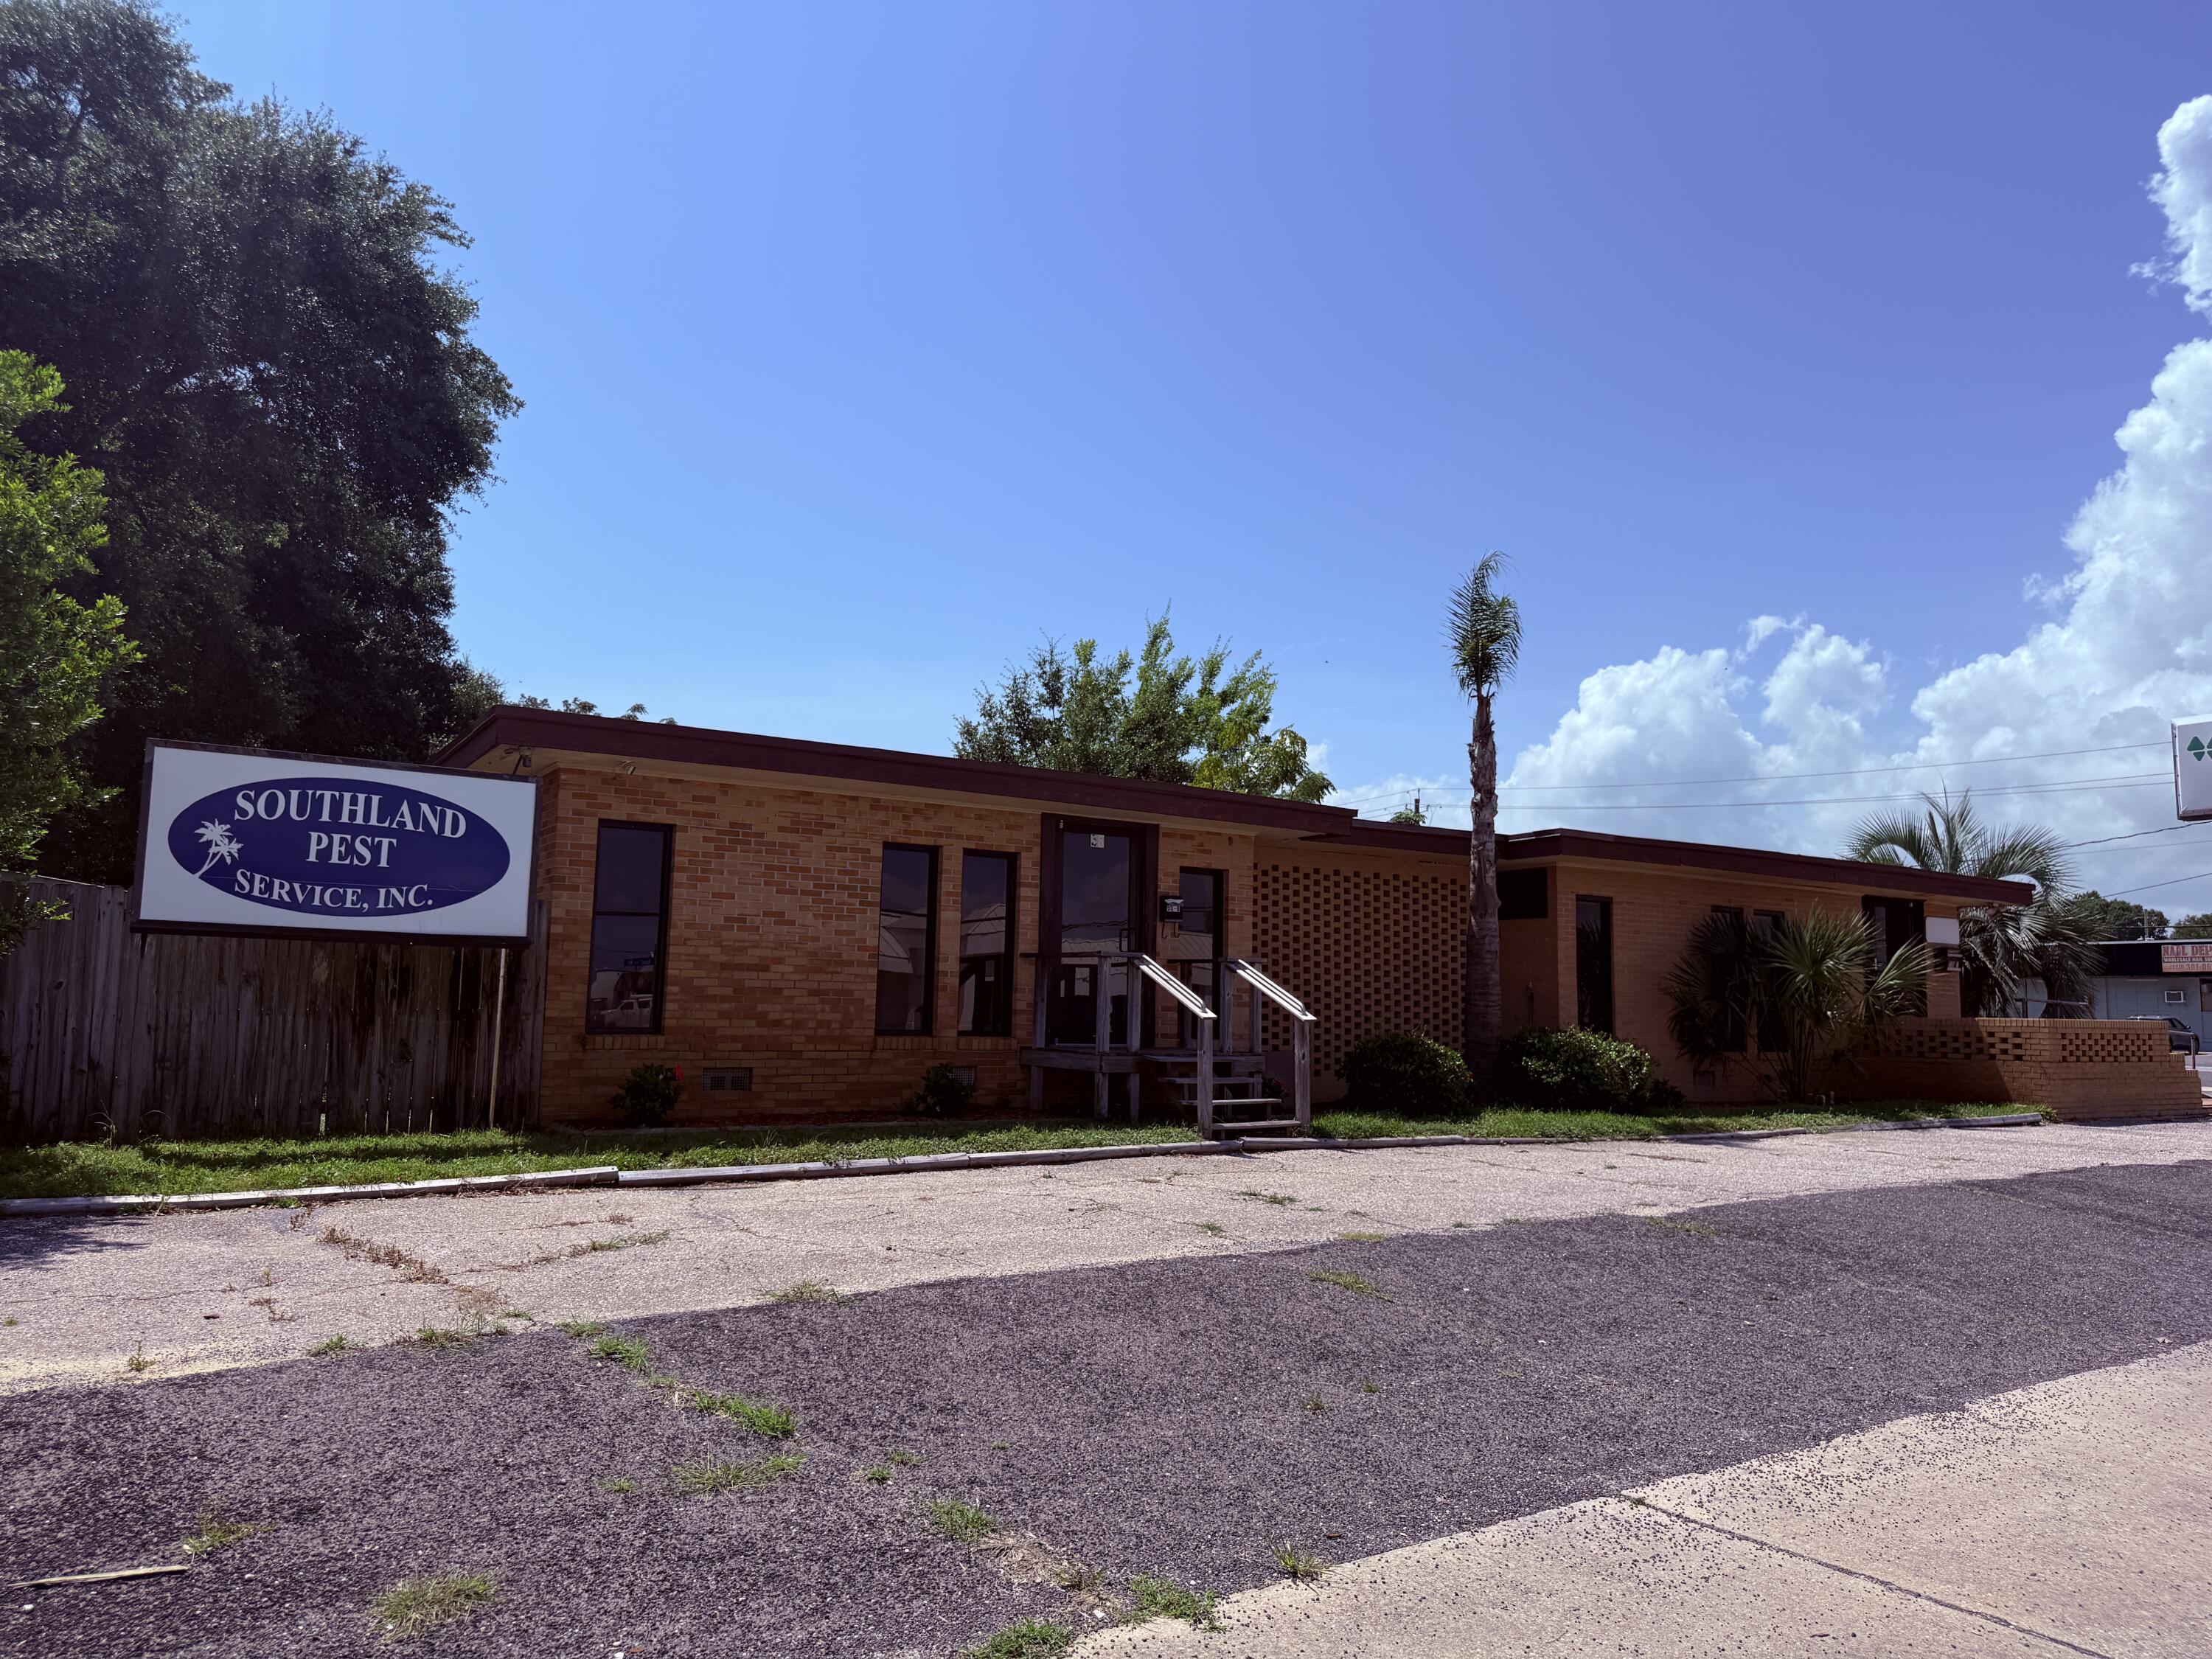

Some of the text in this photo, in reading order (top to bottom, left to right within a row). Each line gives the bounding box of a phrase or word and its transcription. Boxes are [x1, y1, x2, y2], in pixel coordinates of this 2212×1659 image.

[234, 789, 467, 838] SOUTHLAND
[305, 831, 397, 868] PEST
[234, 869, 434, 913] SERVICE, INC.
